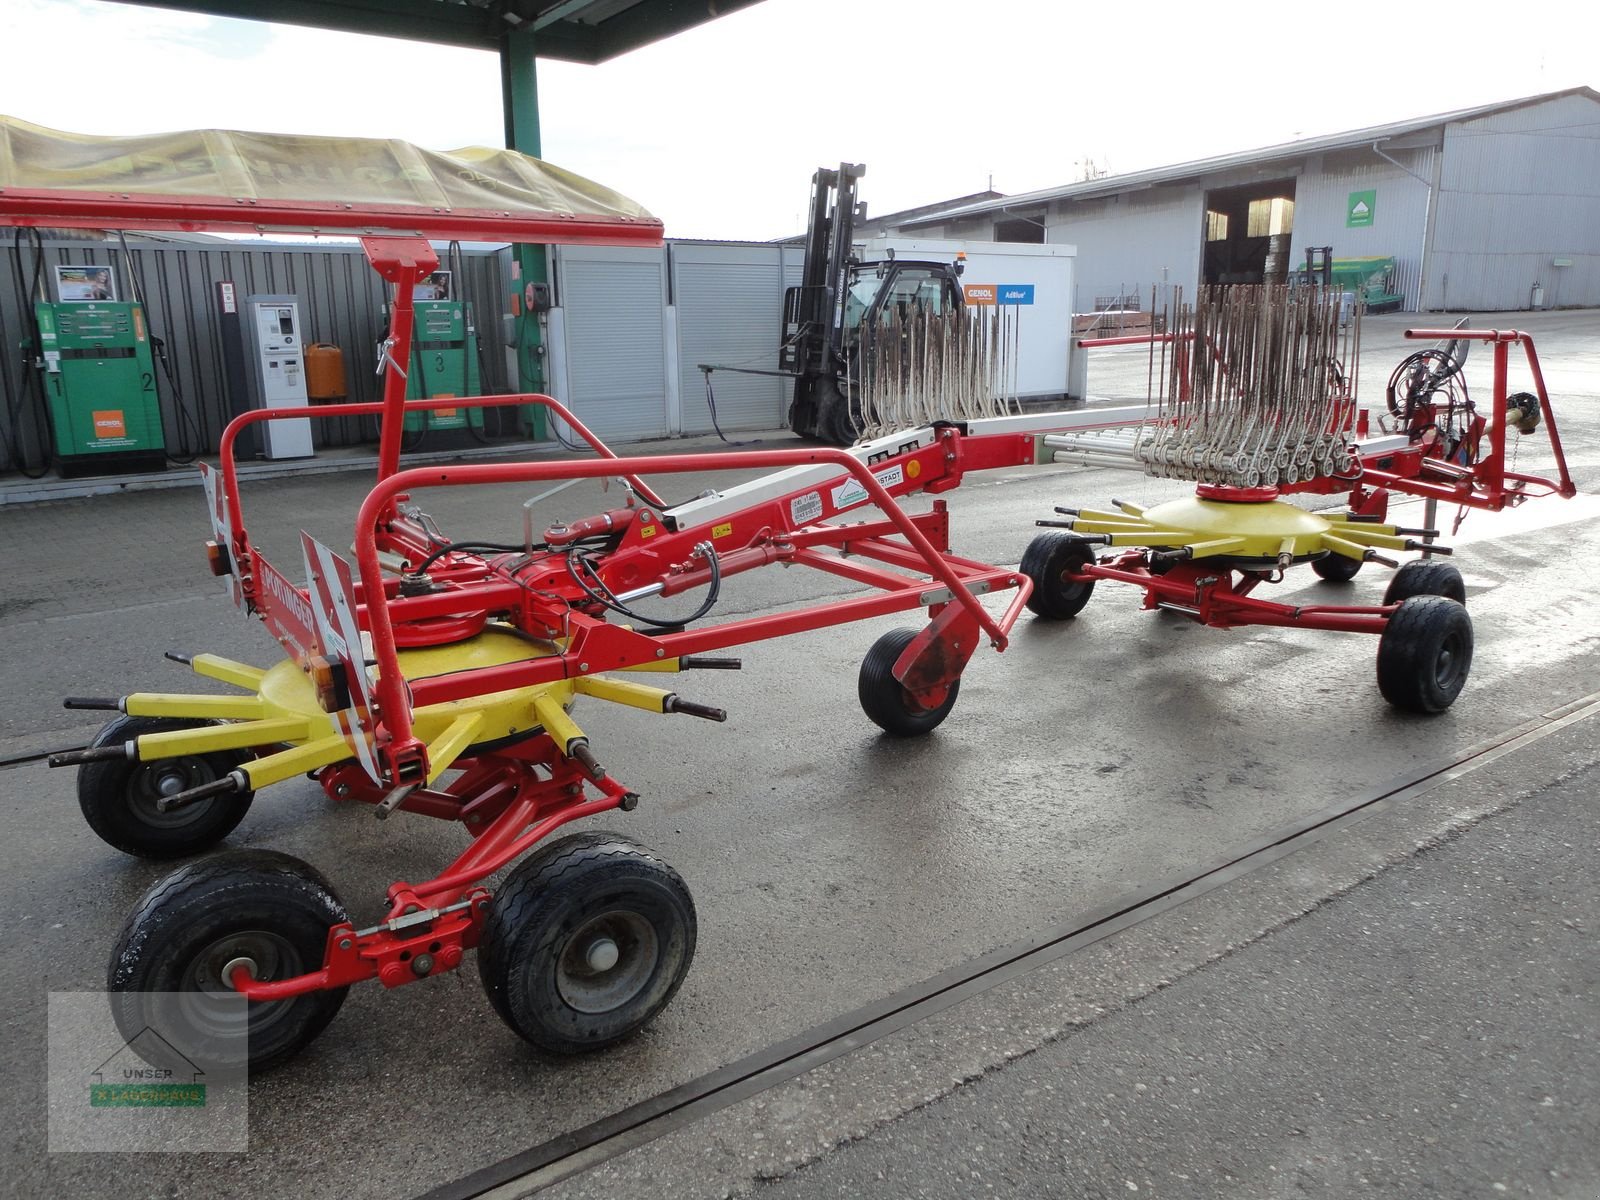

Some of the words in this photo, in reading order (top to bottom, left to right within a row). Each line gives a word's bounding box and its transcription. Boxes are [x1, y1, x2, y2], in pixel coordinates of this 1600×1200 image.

[968, 289, 993, 298] GENOL
[435, 356, 445, 373] 3
[52, 378, 62, 397] 1
[142, 372, 154, 392] 2
